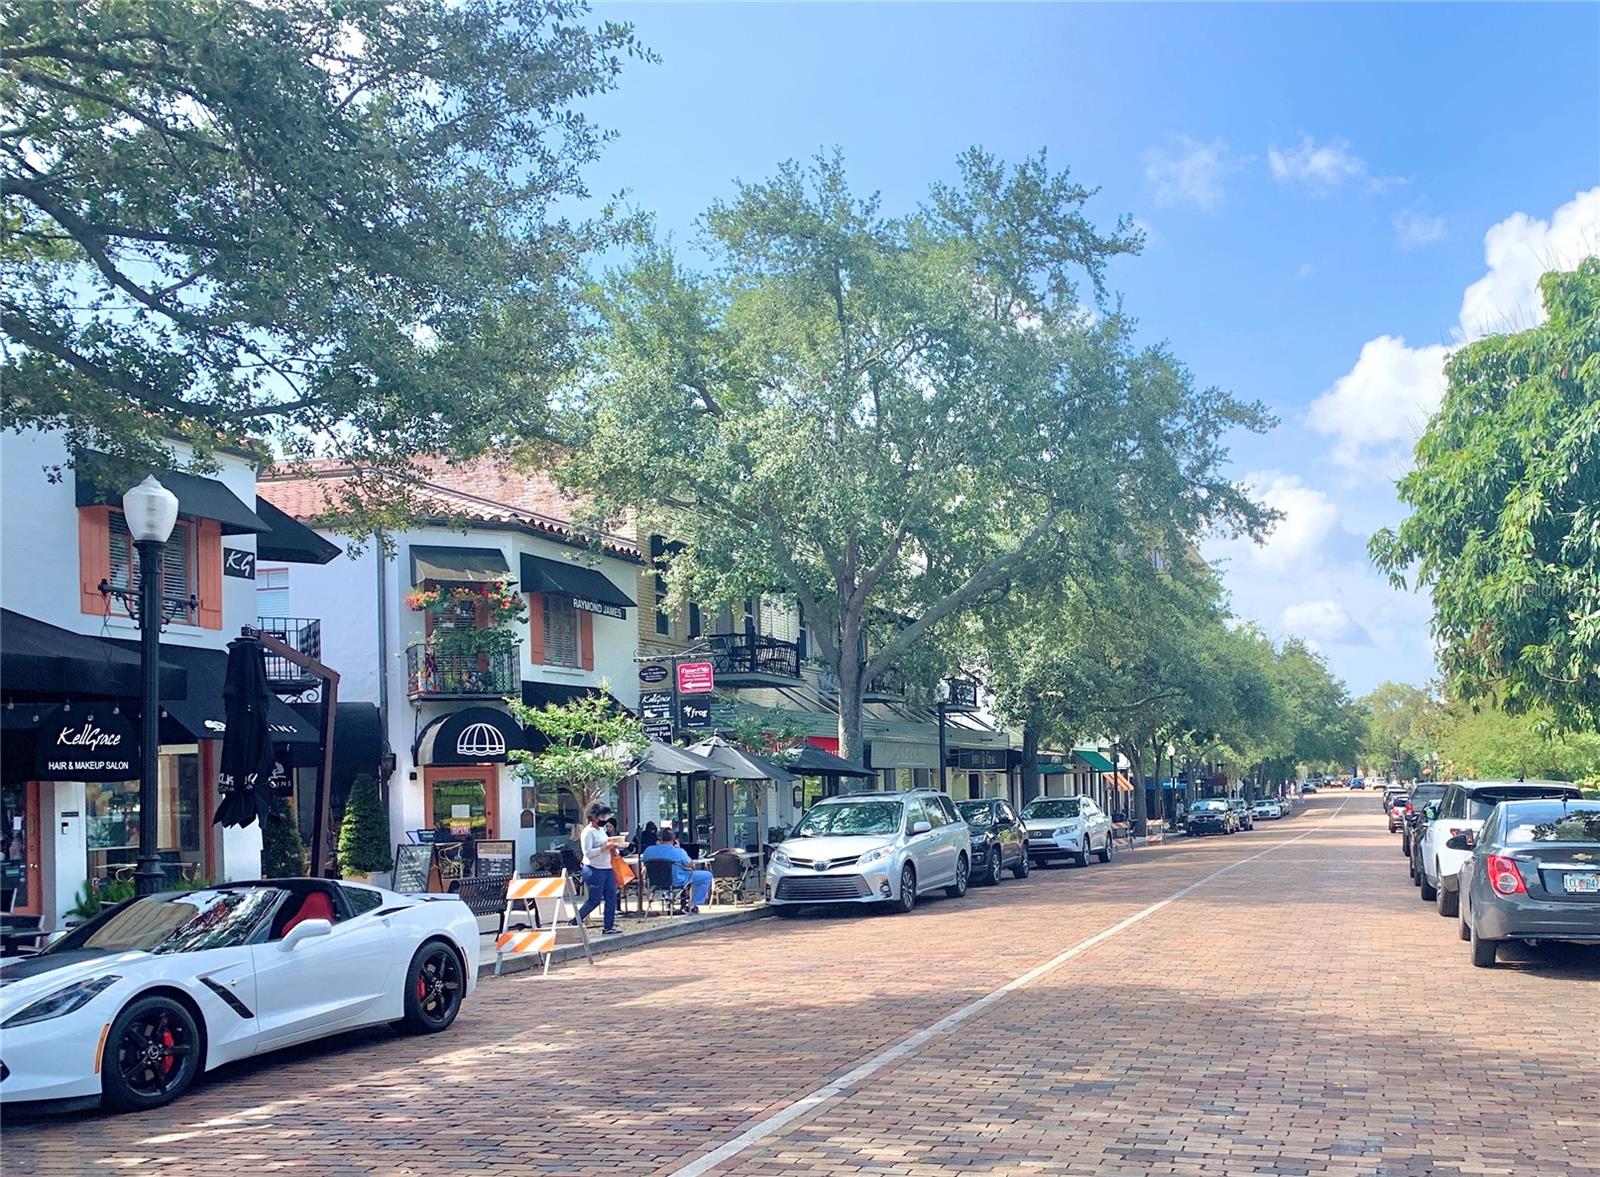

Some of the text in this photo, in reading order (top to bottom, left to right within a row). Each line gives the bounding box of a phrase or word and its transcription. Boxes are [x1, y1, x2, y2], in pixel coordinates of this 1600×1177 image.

[226, 550, 254, 577] KG
[573, 598, 622, 618] RAYMOND JAMES
[690, 708, 708, 718] frog
[56, 723, 121, 751] KellGrace
[48, 761, 129, 770] HAIR & MAKEUP SALON
